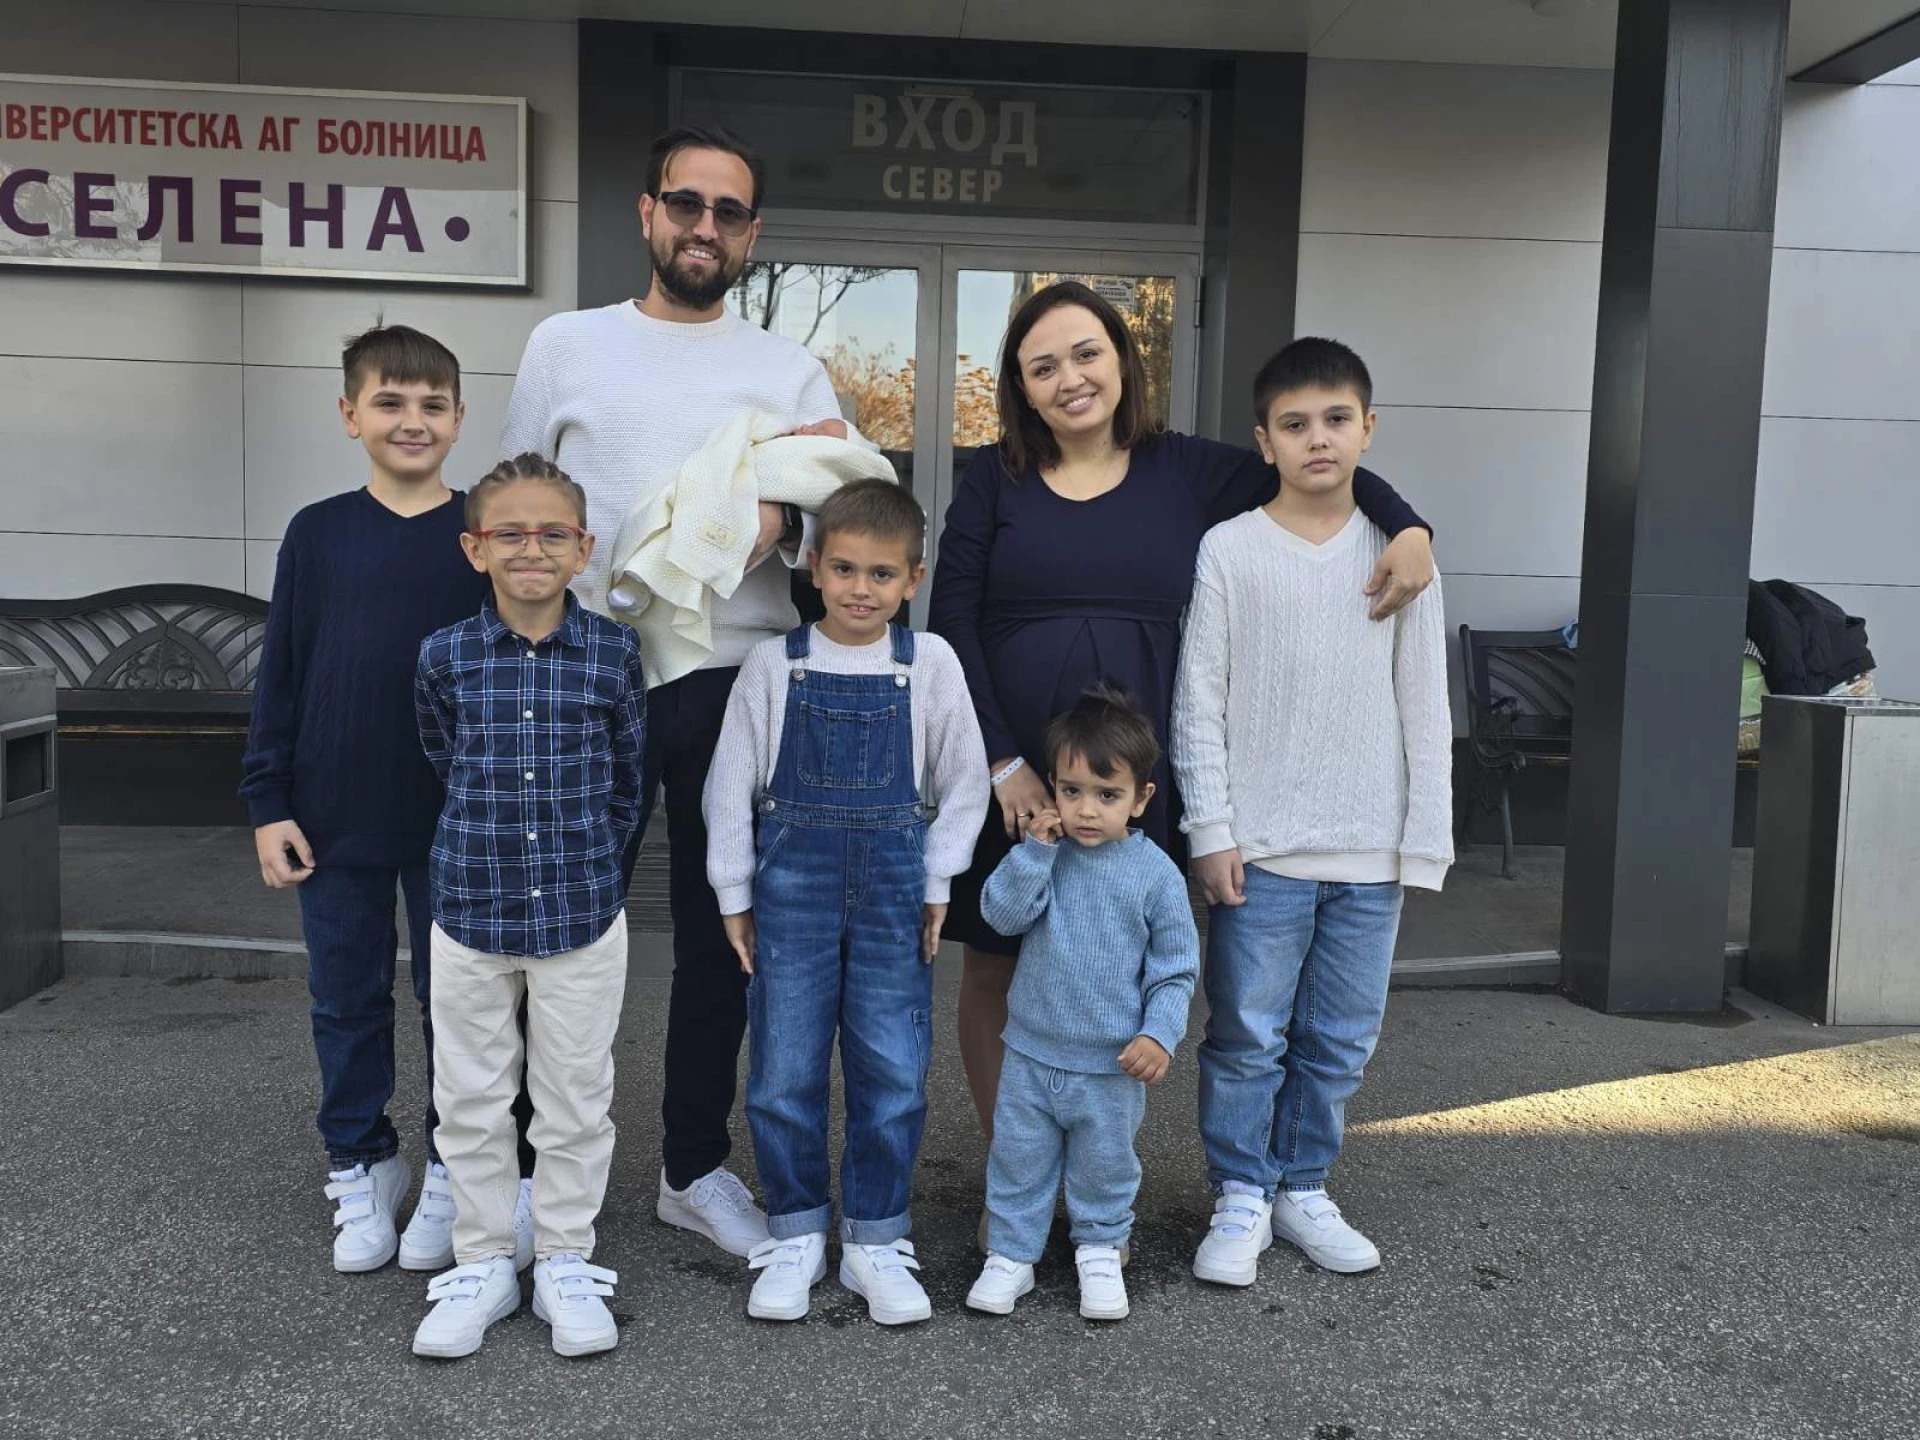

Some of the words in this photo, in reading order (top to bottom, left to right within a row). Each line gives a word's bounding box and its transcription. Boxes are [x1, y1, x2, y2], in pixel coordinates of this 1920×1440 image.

[0, 104, 242, 149] ВЕРСИТЕТСКА
[258, 116, 299, 152] АГ
[317, 119, 487, 163] БОЛНИЦА
[851, 94, 1038, 166] ВХОД
[0, 168, 425, 252] СЕЛЕНА
[882, 165, 1002, 202] СЕВЕР
